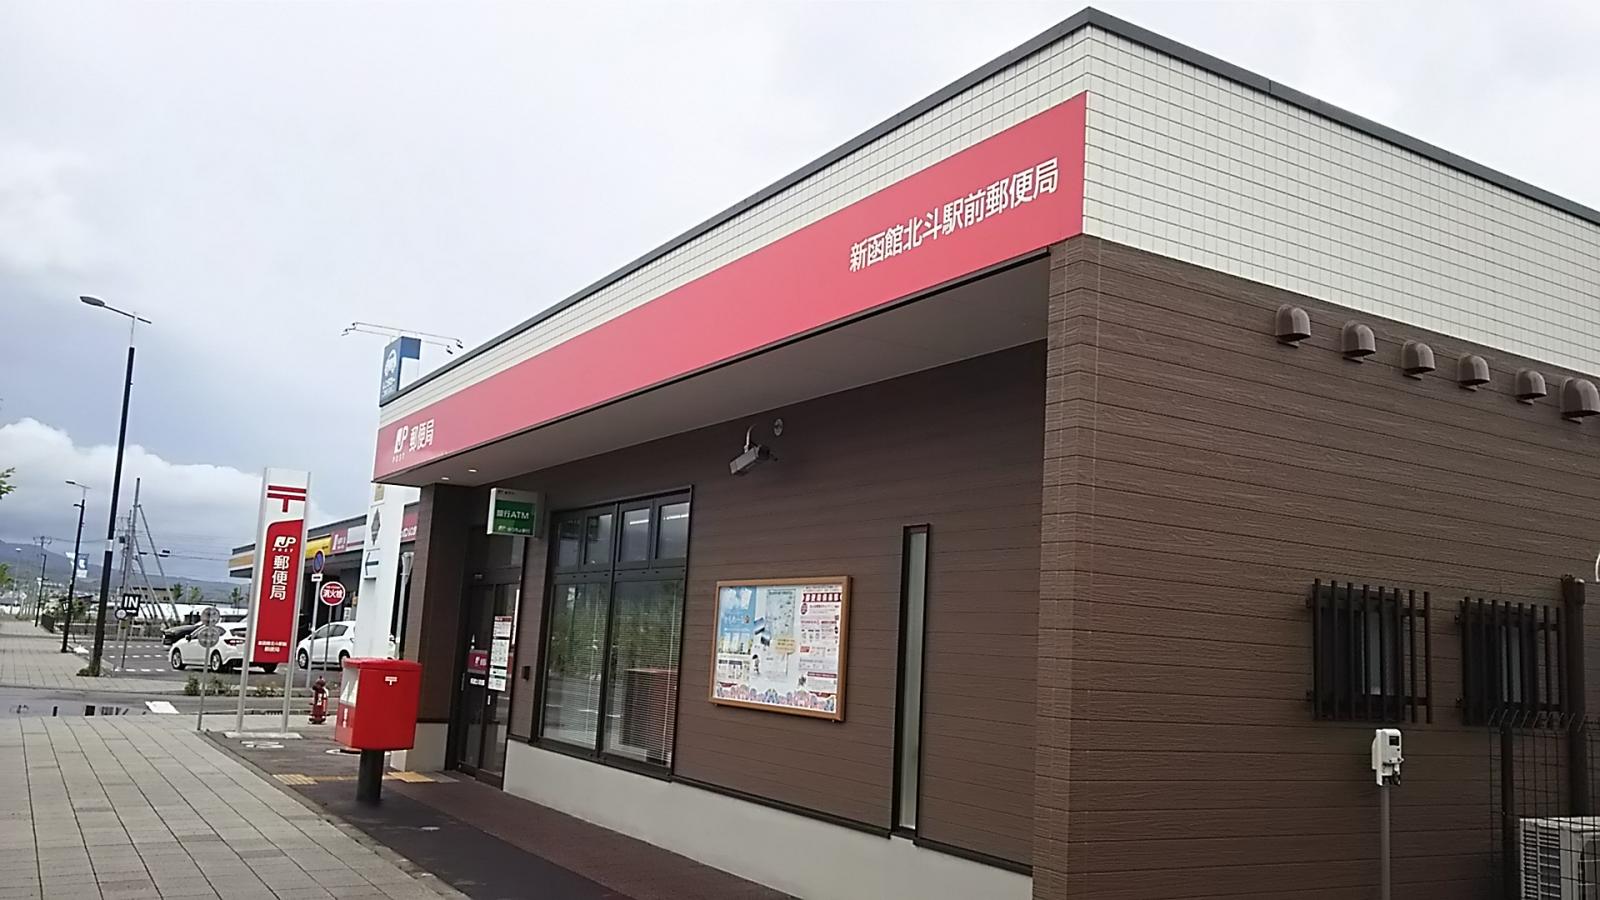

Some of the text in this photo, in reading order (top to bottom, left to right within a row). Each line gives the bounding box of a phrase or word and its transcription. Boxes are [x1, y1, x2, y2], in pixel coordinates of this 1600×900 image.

[849, 157, 1059, 272] 新函館北斗駅前郵便局
[408, 418, 435, 453] 郵便局
[269, 554, 291, 601] 郵便局
[123, 596, 139, 608] IN
